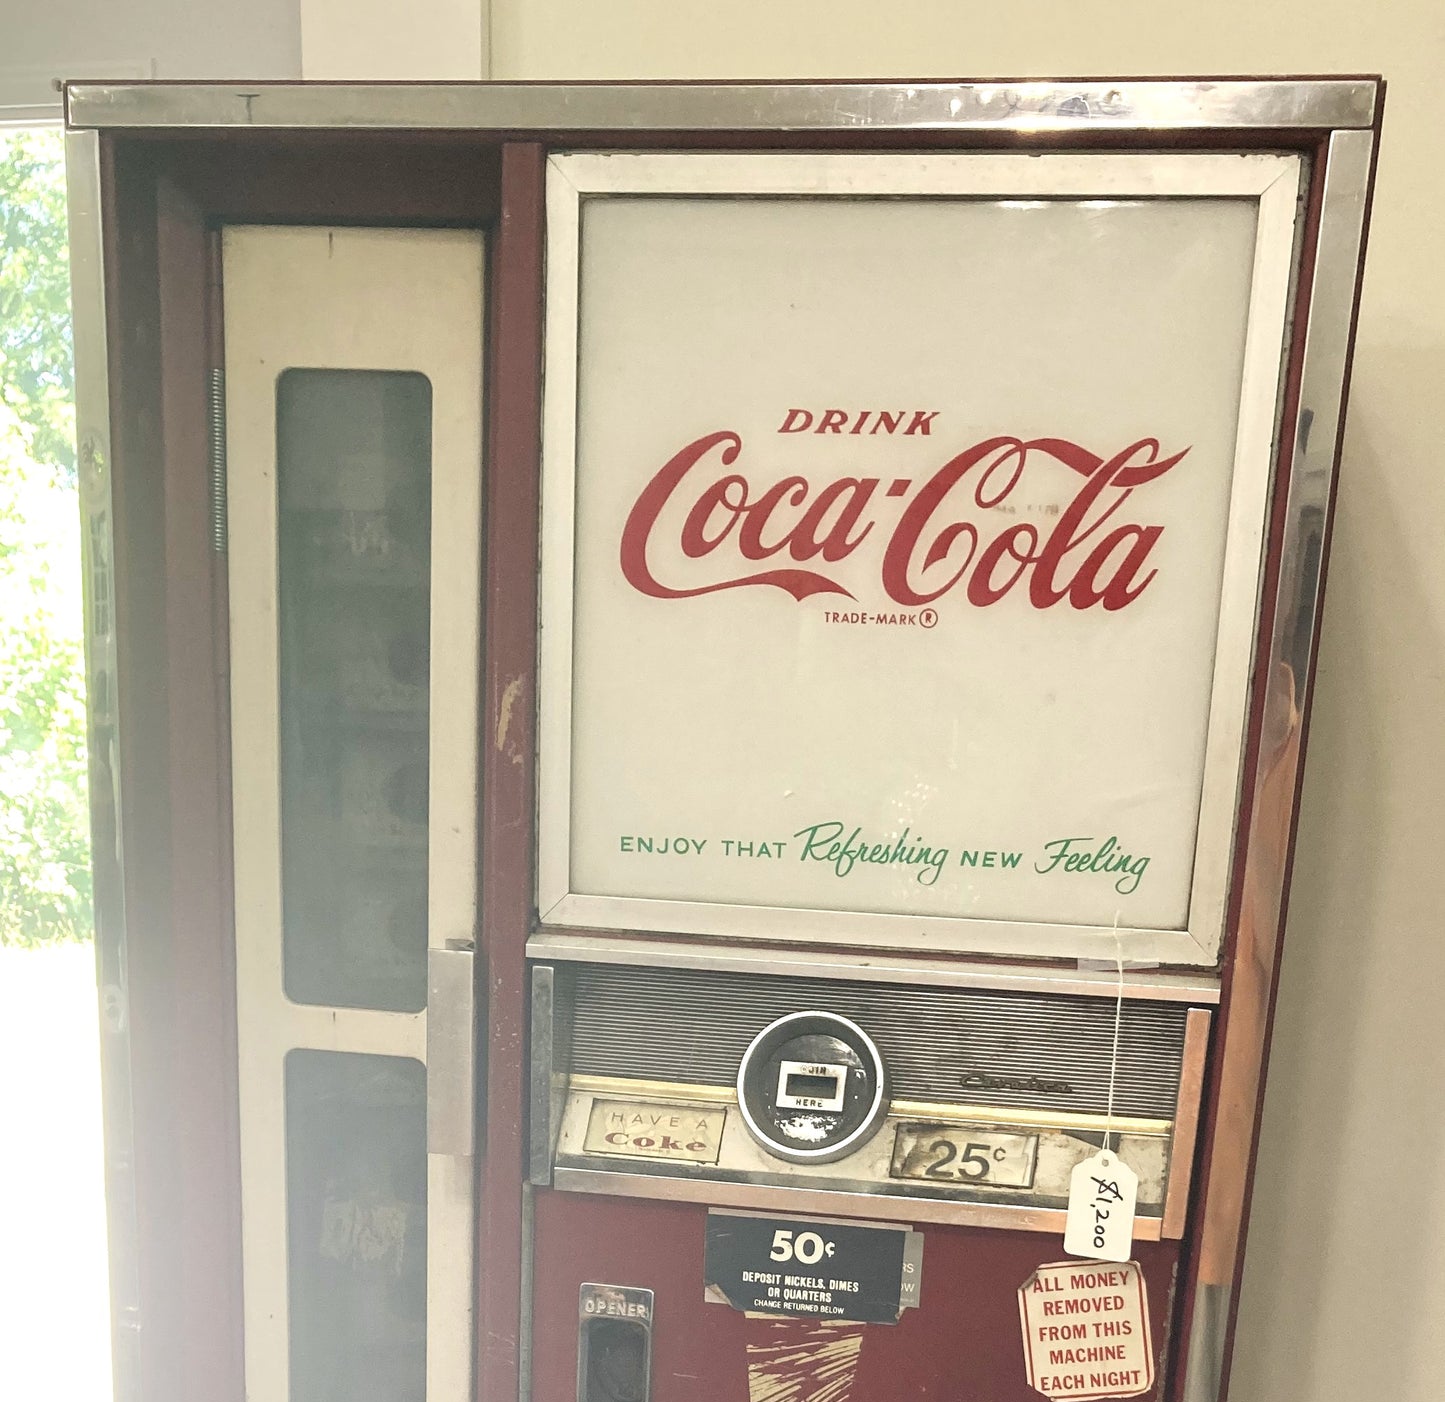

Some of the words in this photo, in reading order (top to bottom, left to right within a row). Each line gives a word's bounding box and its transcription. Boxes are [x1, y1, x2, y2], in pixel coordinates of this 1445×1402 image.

[780, 409, 939, 435] DRINK
[620, 431, 1192, 611] Coca-Cola
[620, 835, 707, 855] ENJOY
[721, 840, 787, 859] THAT
[793, 821, 949, 885] Refreshing
[960, 850, 1023, 869] NEW
[1034, 836, 1151, 895] Feeling
[795, 1098, 823, 1108] HERE
[611, 1112, 681, 1128] HAVE
[696, 1119, 709, 1129] A
[604, 1131, 708, 1152] Coke
[1091, 1176, 1123, 1249] $1,200
[769, 1230, 836, 1265] 50¢
[742, 1271, 782, 1286] DEPOSIT
[829, 1280, 860, 1294] DIMES
[1033, 1275, 1065, 1294] ALL
[1070, 1270, 1130, 1290] MONEY
[767, 1286, 781, 1298] OR
[783, 1287, 832, 1304] QUARTERS
[1043, 1295, 1125, 1317] REMOVED
[584, 1298, 647, 1318] OPENER
[753, 1298, 782, 1310] CHANGE
[783, 1301, 819, 1313] RETURNED
[820, 1304, 845, 1315] BELOW
[1038, 1323, 1088, 1343] FROM
[1092, 1319, 1133, 1339] THIS
[1049, 1345, 1127, 1366] MACHINE
[1040, 1374, 1086, 1392] EACH
[1090, 1370, 1141, 1389] NIGHT
